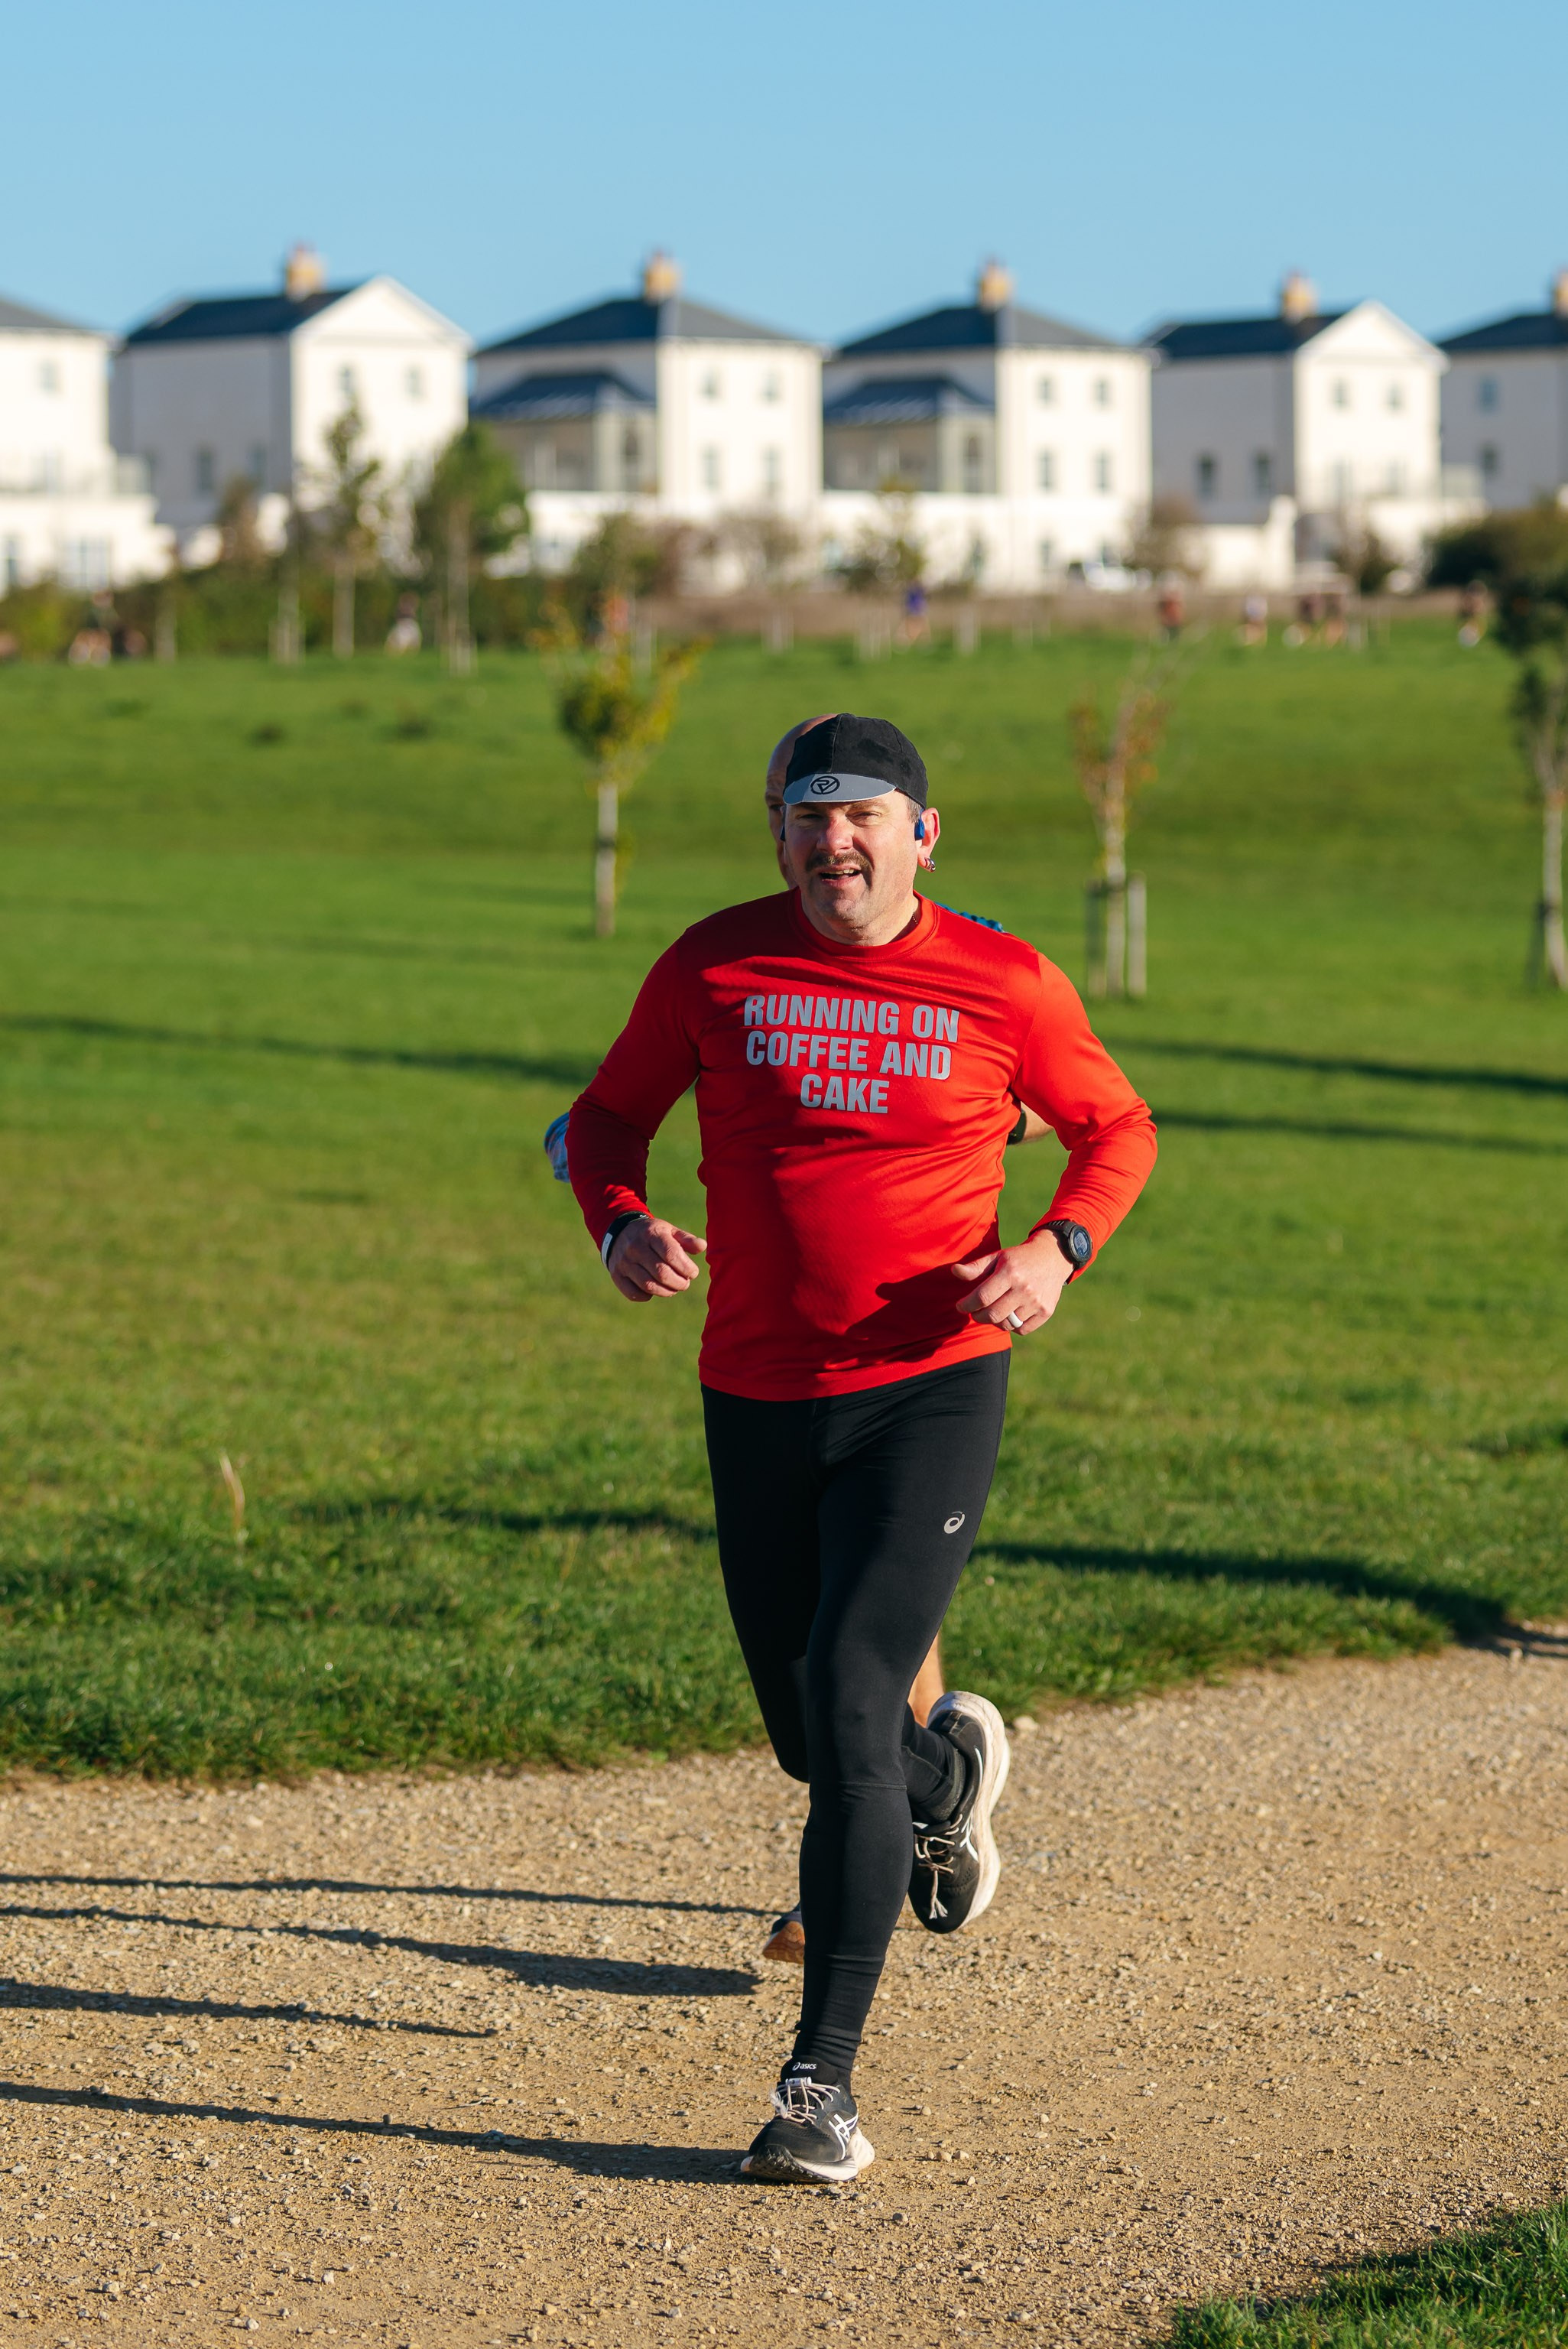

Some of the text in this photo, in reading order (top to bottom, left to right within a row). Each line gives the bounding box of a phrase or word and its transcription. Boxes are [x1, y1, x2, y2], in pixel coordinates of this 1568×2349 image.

[743, 995, 960, 1042] RUNNING ON
[746, 1031, 951, 1080] COFFEE AND
[800, 1074, 889, 1113] CAKE
